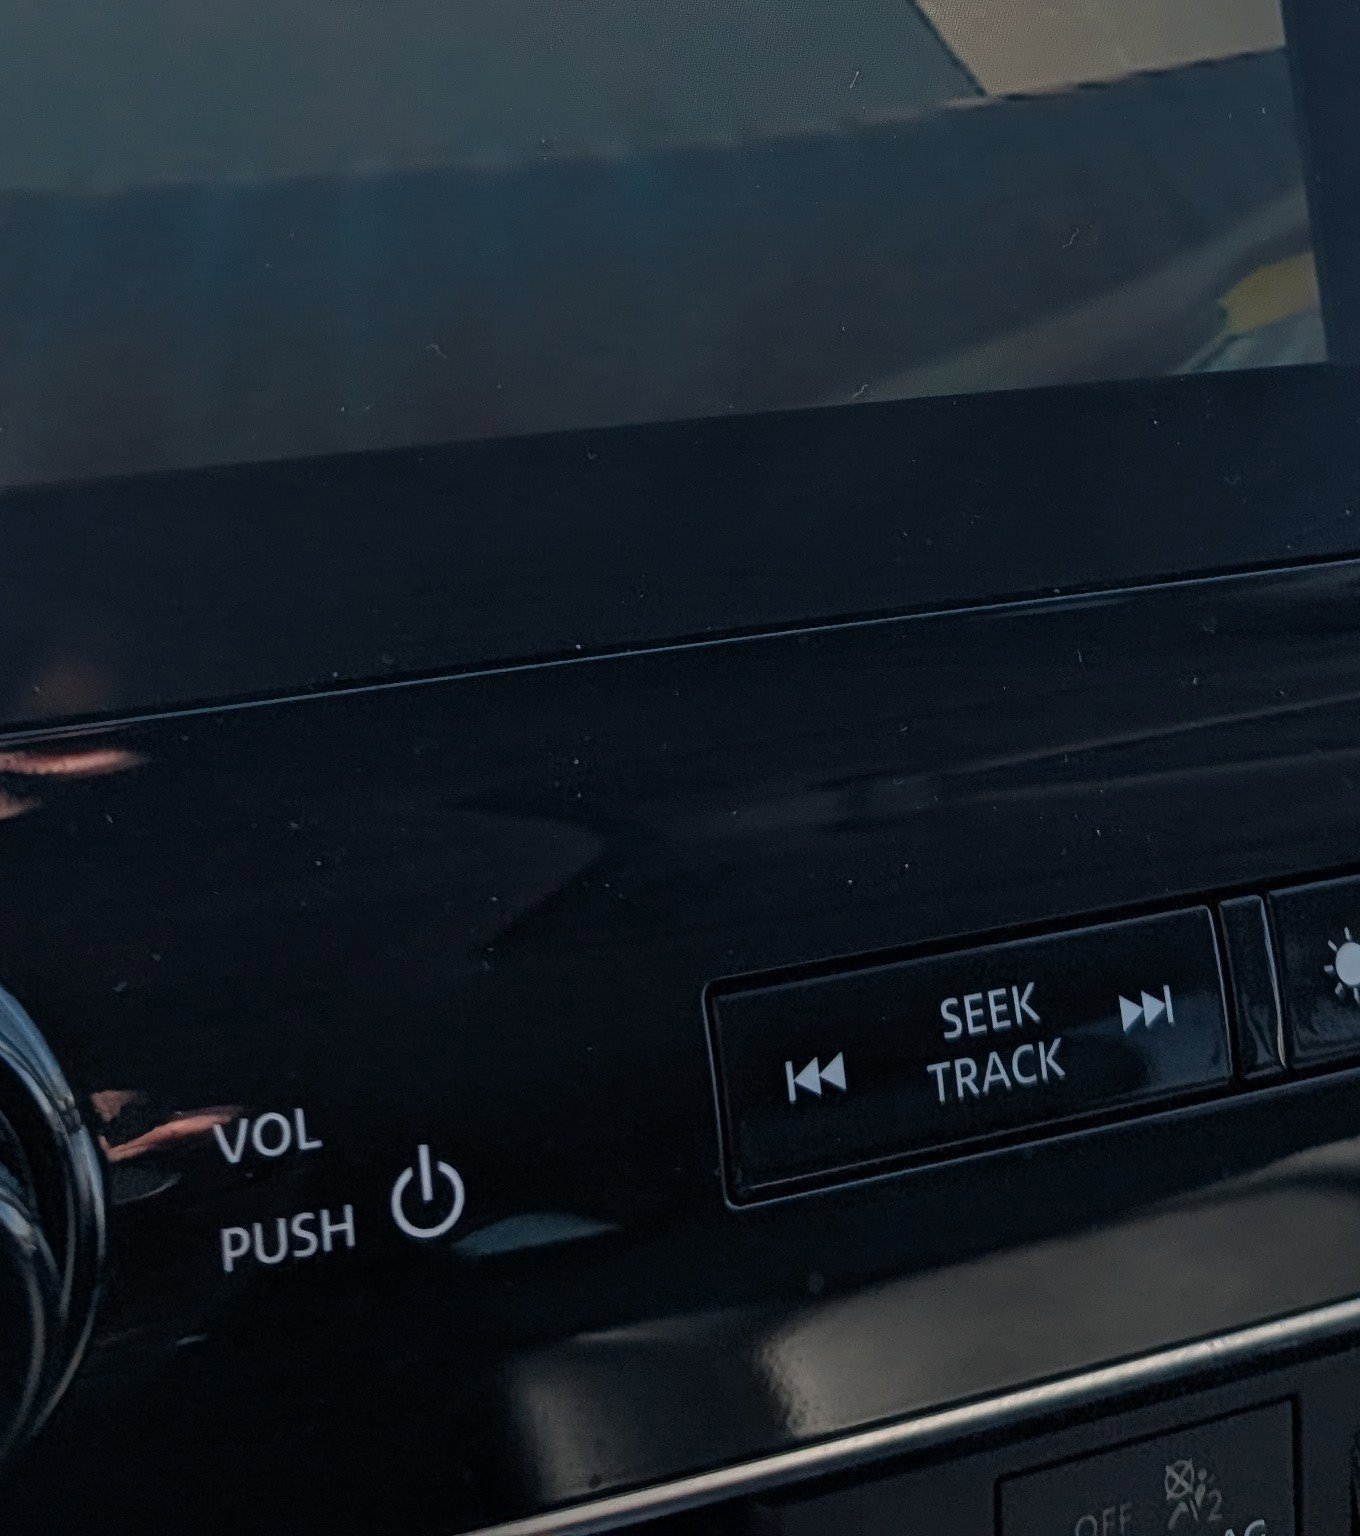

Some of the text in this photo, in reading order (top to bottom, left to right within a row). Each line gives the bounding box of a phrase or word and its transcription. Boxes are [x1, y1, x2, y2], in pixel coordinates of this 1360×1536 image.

[940, 981, 1041, 1040] SEEK
[927, 1037, 1067, 1104] TRACK
[211, 1107, 324, 1165] VOL
[219, 1203, 357, 1274] PUSH
